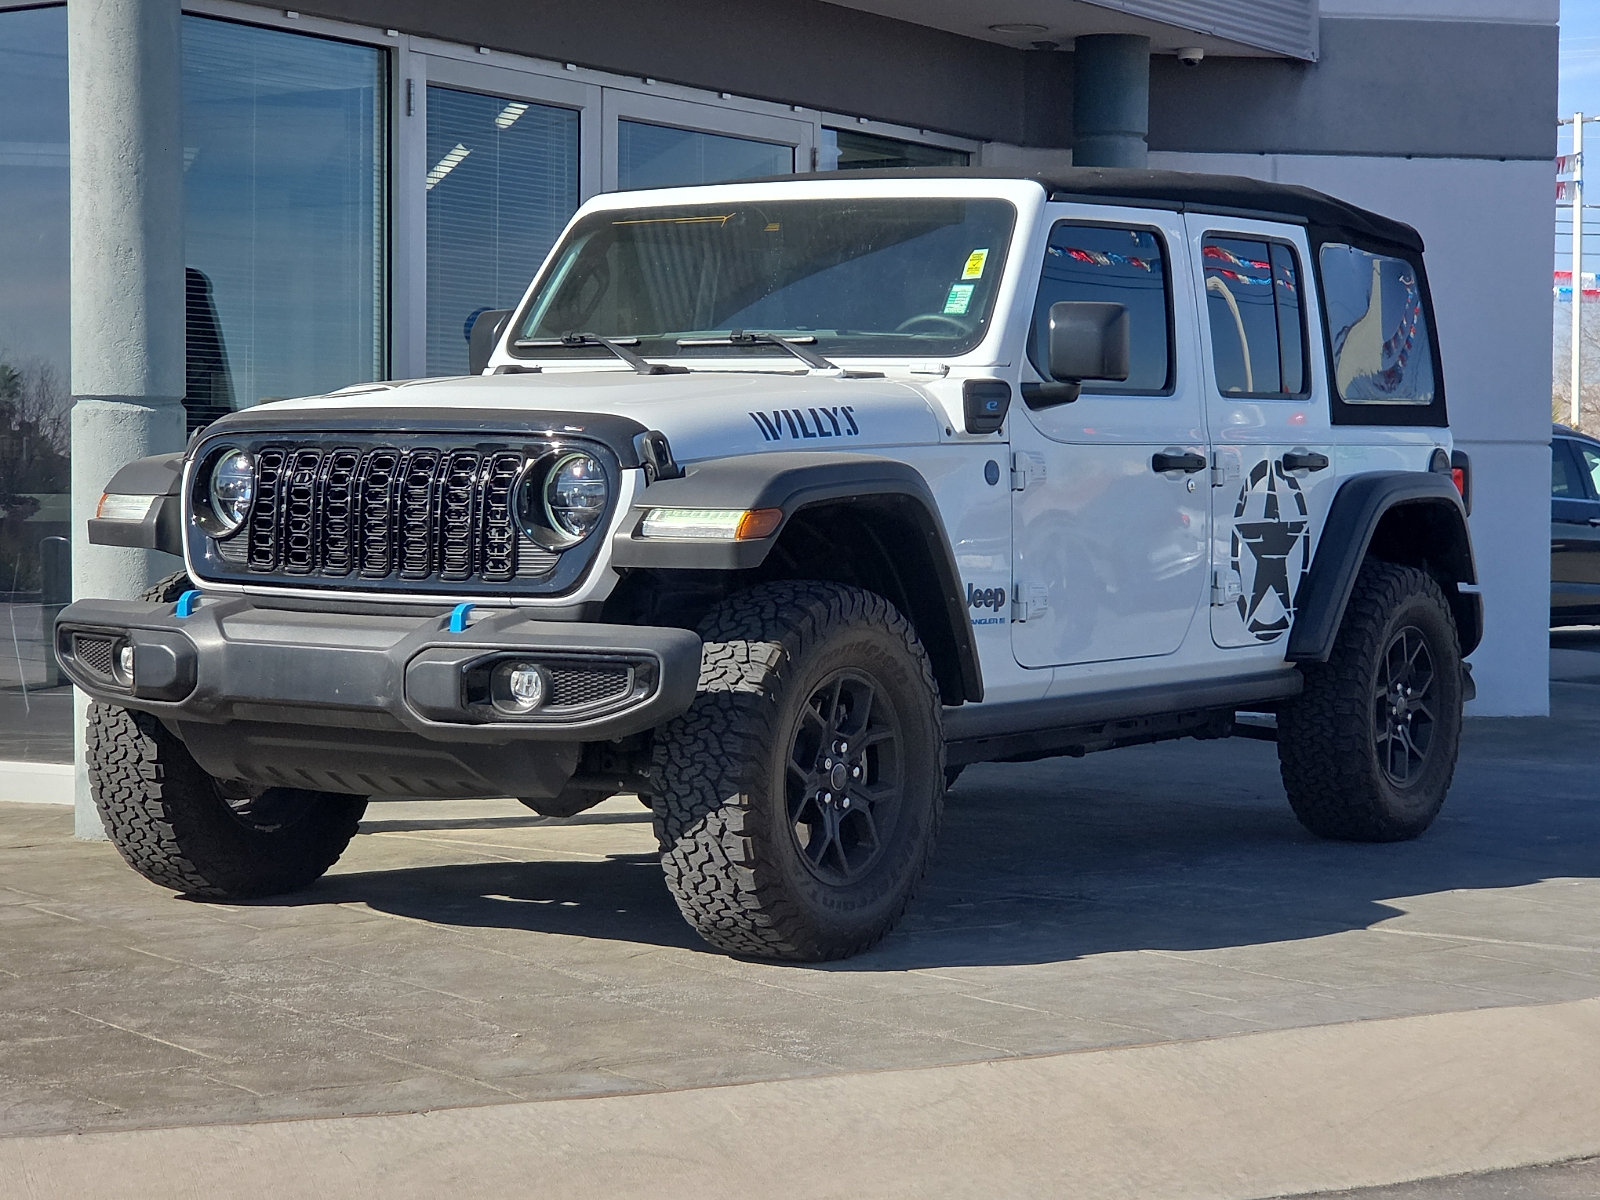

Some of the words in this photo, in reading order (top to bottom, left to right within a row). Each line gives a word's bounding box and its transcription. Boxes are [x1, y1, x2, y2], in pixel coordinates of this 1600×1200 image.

[748, 406, 859, 441] WILLYS
[967, 582, 1006, 613] Jeep
[970, 617, 998, 625] ANGLER
